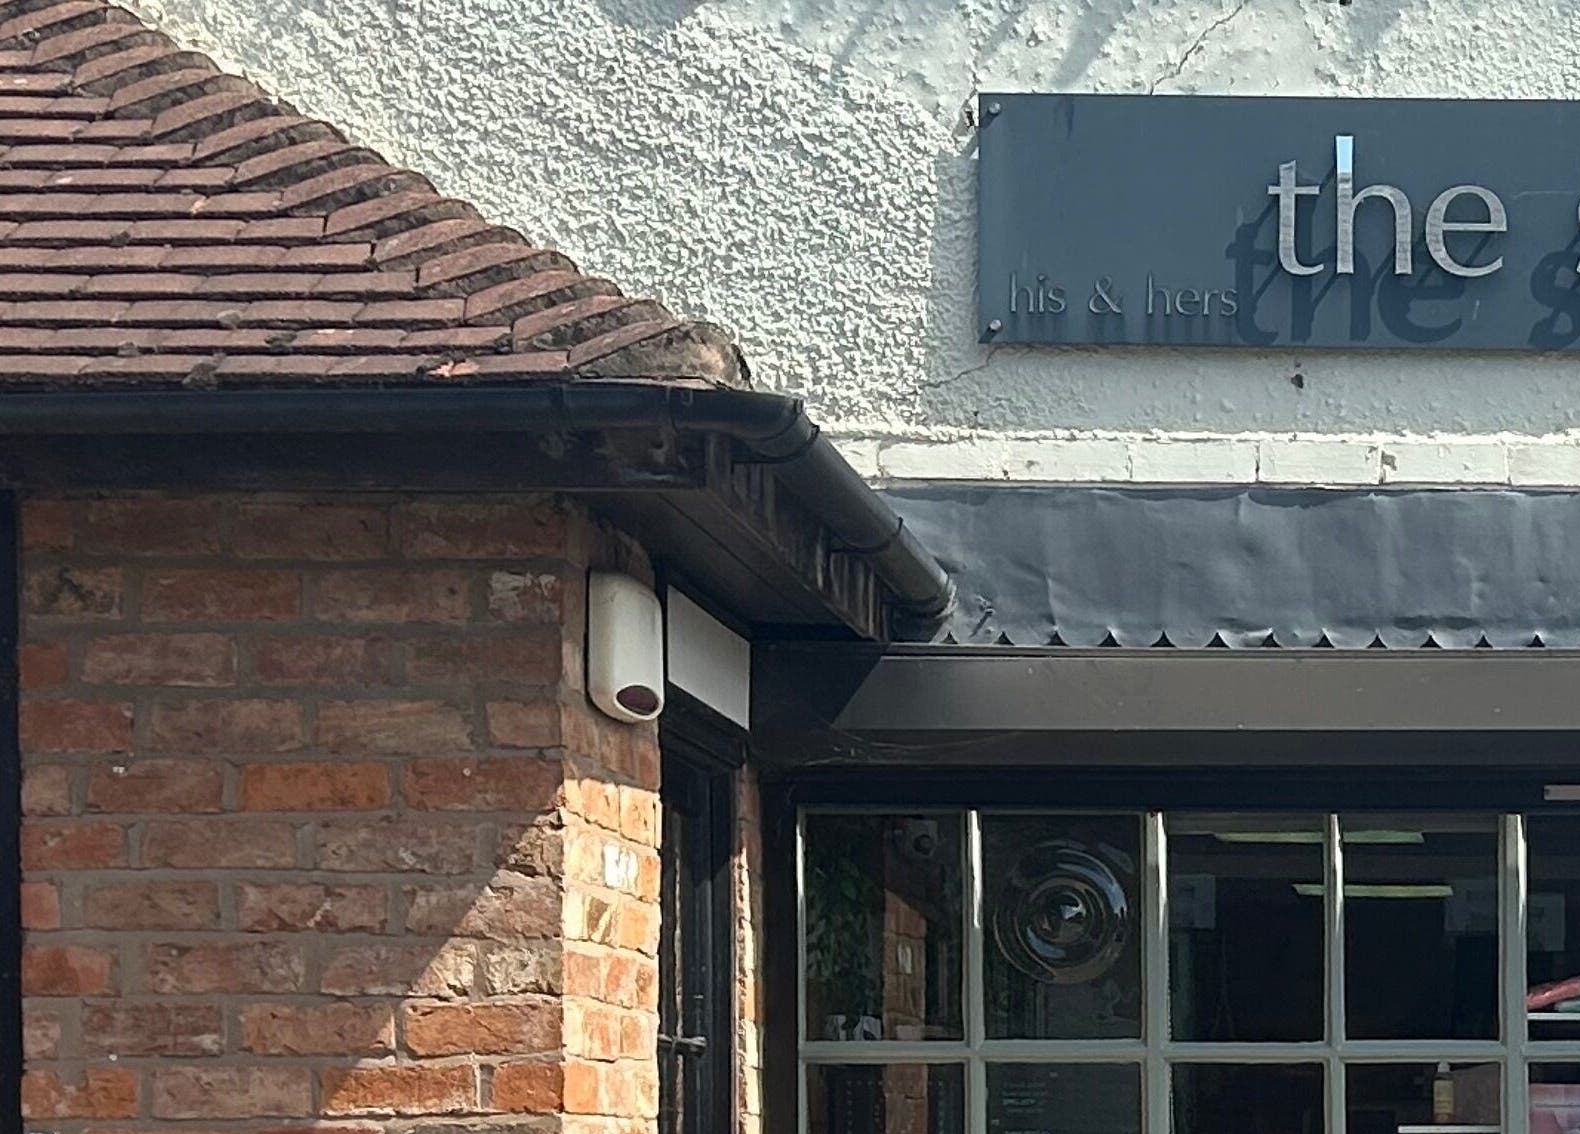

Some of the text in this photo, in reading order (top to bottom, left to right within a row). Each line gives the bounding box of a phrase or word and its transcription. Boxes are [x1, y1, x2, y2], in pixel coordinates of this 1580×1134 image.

[1267, 134, 1508, 278] the
[1009, 272, 1239, 317] his & hers
